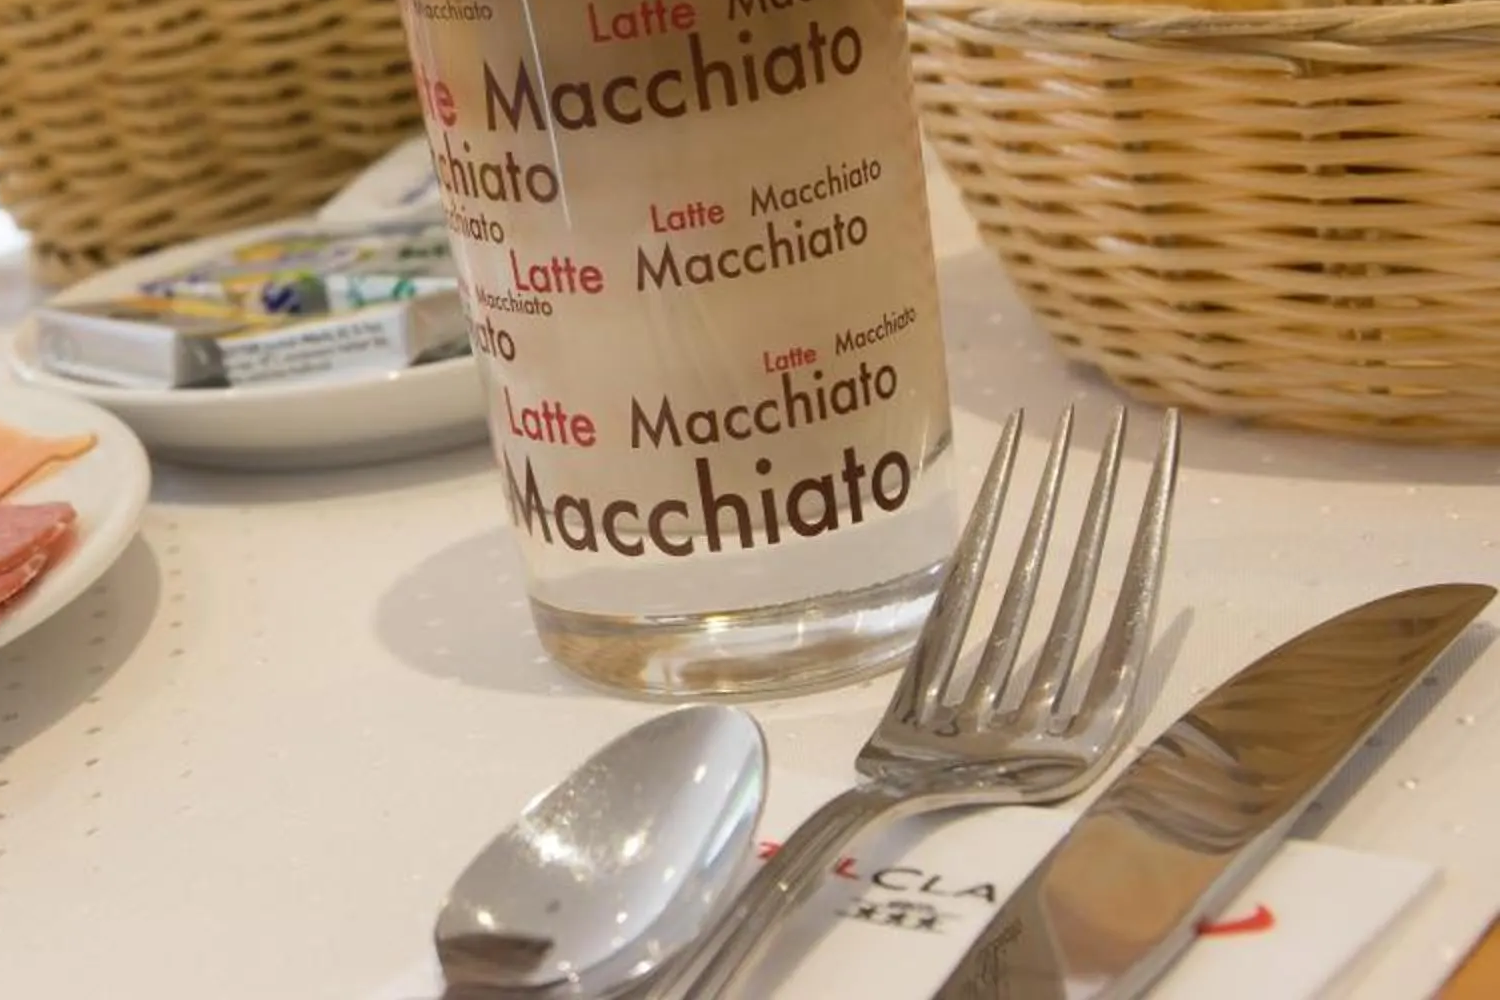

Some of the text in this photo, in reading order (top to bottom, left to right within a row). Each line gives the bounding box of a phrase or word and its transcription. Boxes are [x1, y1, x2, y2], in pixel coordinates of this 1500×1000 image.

[483, 21, 862, 133] Macchiato
[433, 132, 559, 204] chiato
[650, 158, 882, 233] Latte Macchiato
[510, 214, 868, 294] Latte Macchiato
[763, 307, 917, 373] Latte Macchiato
[504, 361, 897, 449] Latte Macchiato
[503, 446, 911, 557] Macchiato
[871, 867, 996, 903] CLA
